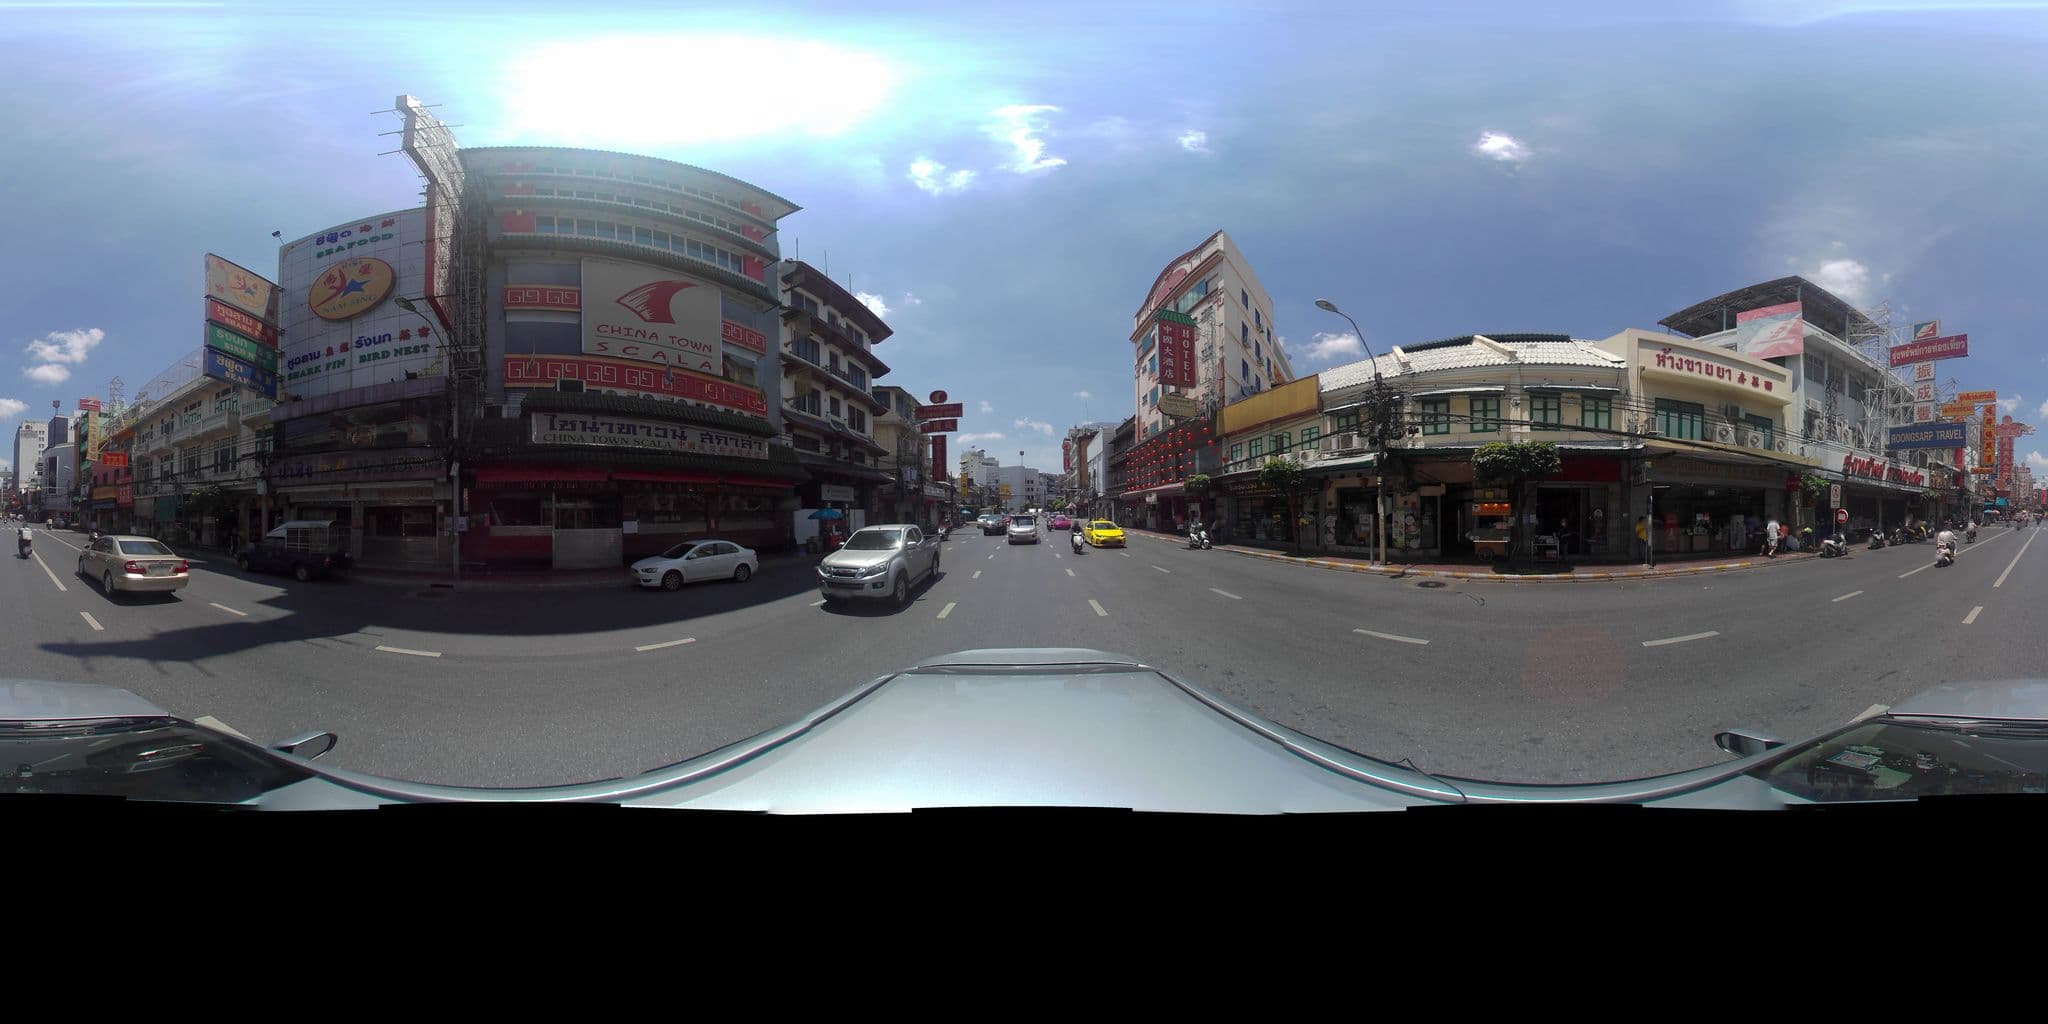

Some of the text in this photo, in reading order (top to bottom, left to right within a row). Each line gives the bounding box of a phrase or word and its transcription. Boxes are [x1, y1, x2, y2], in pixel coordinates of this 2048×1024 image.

[316, 233, 394, 258] SEAFOOD
[355, 333, 392, 349] รังนก
[596, 324, 712, 353] CHINA TOWN
[358, 343, 431, 364] BIRD NEST
[595, 341, 712, 370] SCALA
[1182, 329, 1191, 382] HOTEL
[1656, 347, 1732, 382] ห้างขายยา
[288, 358, 346, 381] SHARK FIN
[544, 414, 688, 441] ไชน่าทาวน์
[1890, 429, 1964, 444] ROONGSARP TRAVEL
[543, 432, 585, 443] CHINA
[591, 435, 630, 445] TOWN
[633, 438, 672, 449] SCALA
